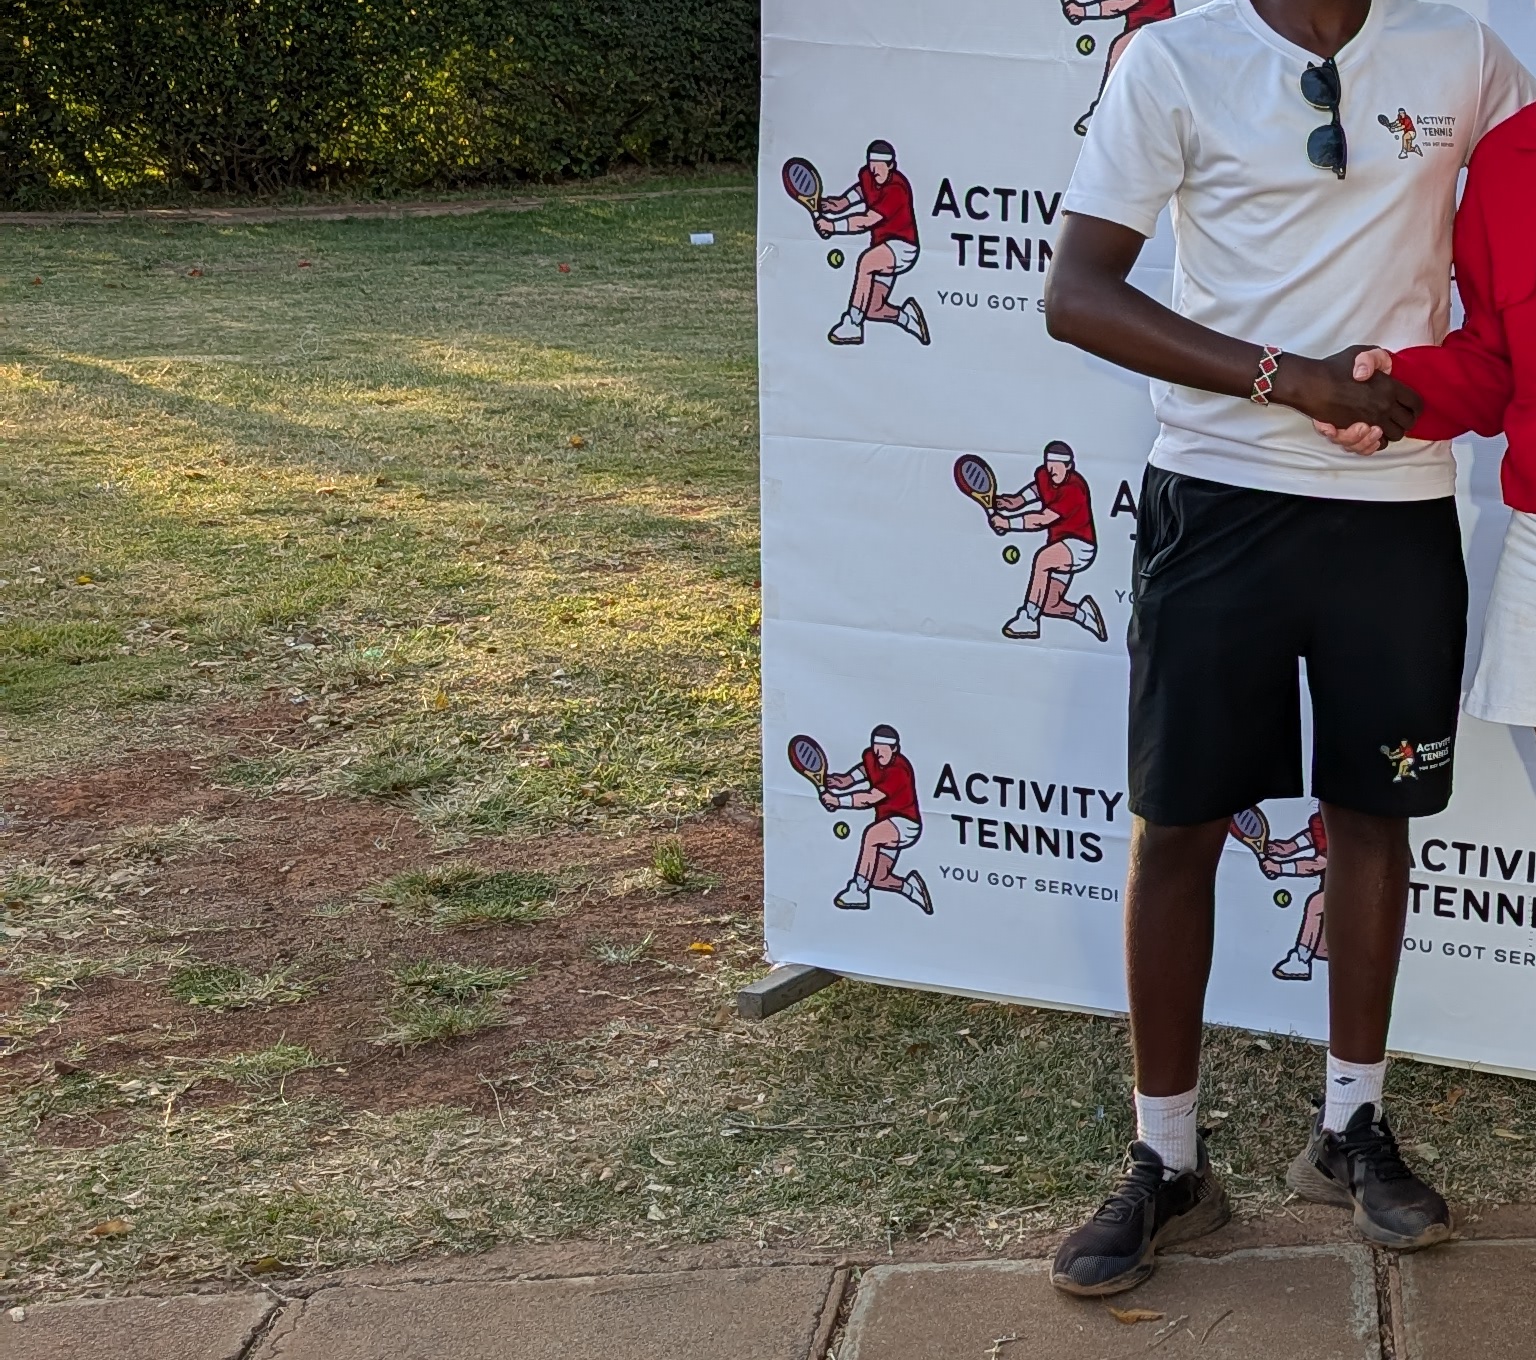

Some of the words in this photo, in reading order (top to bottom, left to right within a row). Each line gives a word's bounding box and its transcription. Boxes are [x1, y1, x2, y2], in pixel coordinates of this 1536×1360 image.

[1416, 114, 1456, 126] ACTIVITY
[1422, 127, 1453, 137] TENNIS
[931, 177, 1063, 225] ACTIV
[950, 232, 1053, 273] TENN
[937, 290, 979, 307] YOU
[987, 294, 1029, 311] GOT
[933, 763, 1124, 822] ACTIVITY
[950, 813, 1103, 863] TENNIS
[939, 865, 979, 883] YOU
[987, 872, 1027, 890] GOT
[1034, 878, 1119, 902] SERVED!
[1403, 937, 1433, 953] OU
[1442, 942, 1486, 960] GOT
